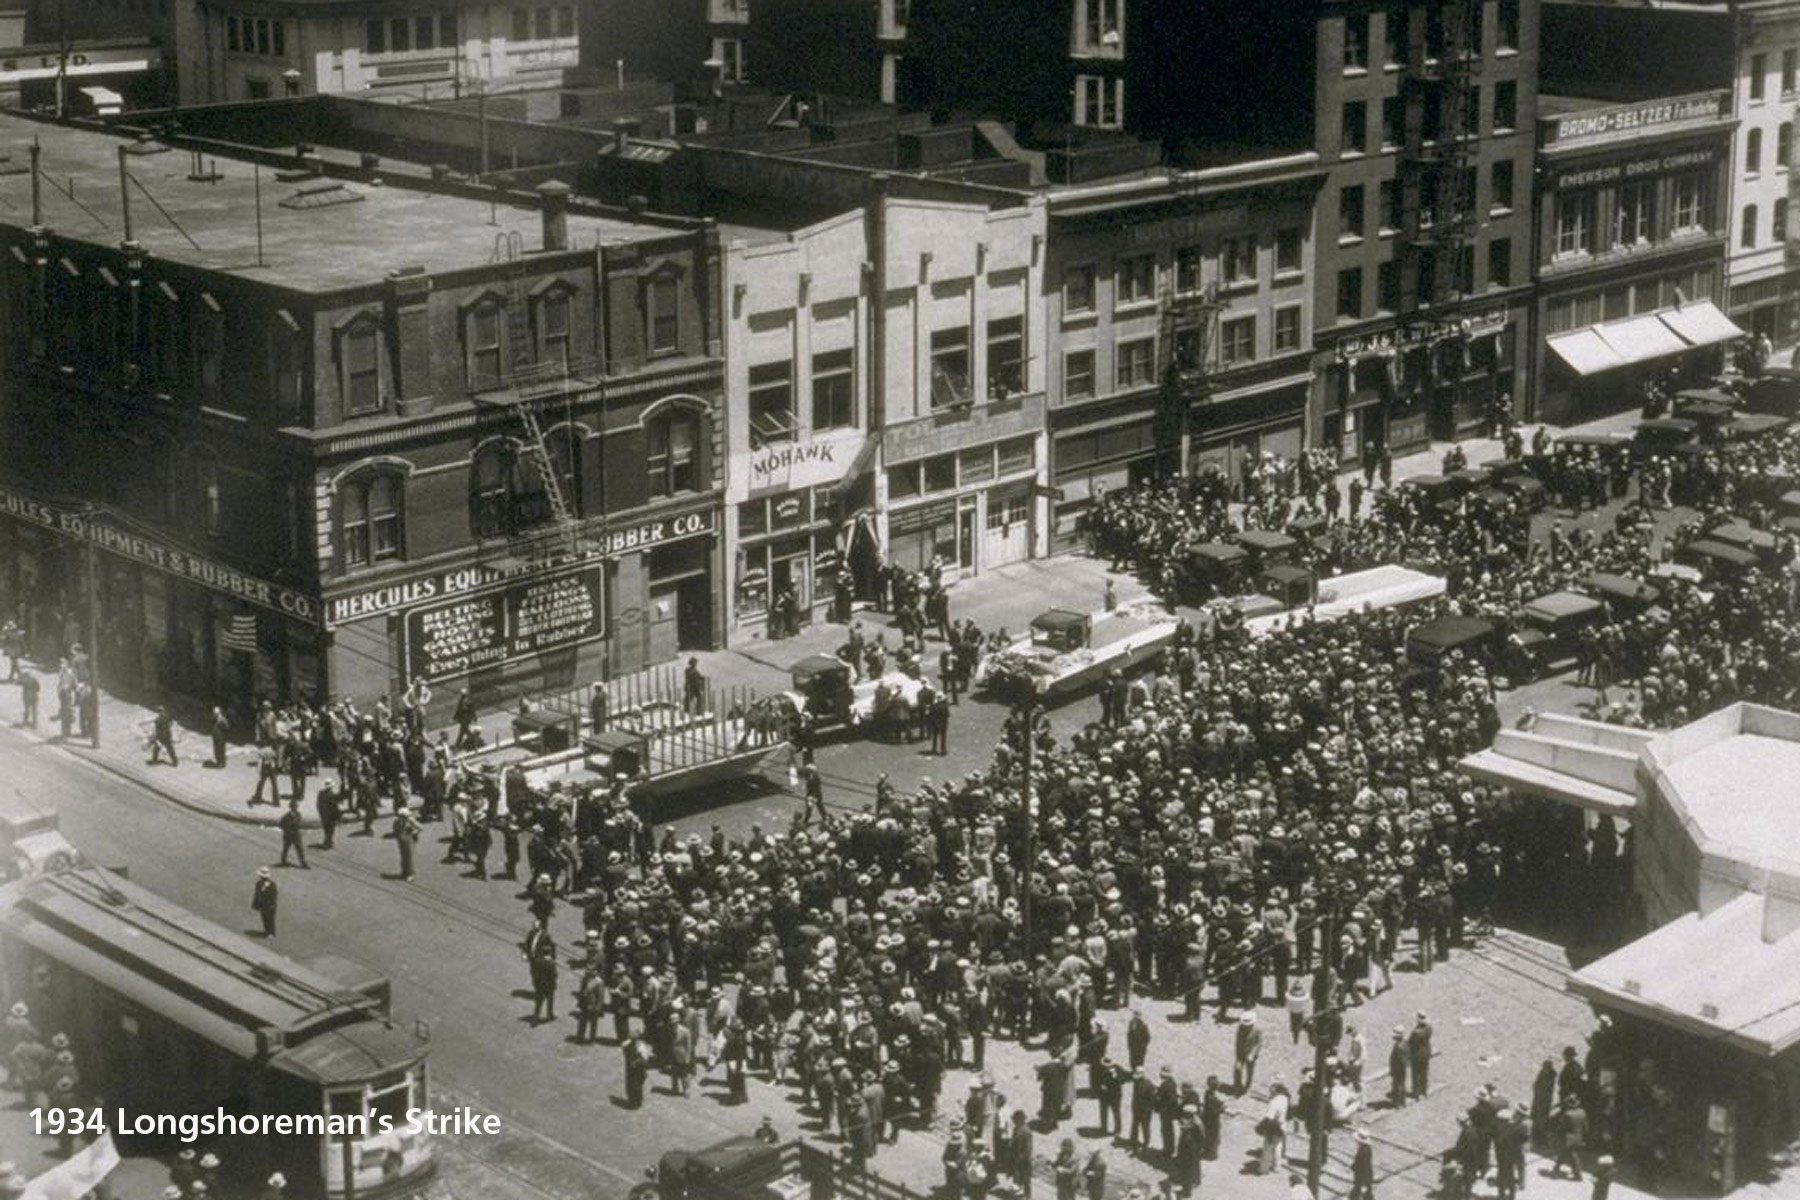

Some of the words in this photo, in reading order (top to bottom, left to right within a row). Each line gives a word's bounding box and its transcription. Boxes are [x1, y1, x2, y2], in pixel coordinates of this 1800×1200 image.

[1559, 105, 1673, 137] BROMO-SELTZER
[1559, 166, 1621, 188] EMERSON
[1626, 159, 1660, 176] DRUG
[1663, 150, 1713, 169] COMPANY
[754, 445, 834, 480] MOHAWK
[334, 577, 437, 620] HERCULES
[673, 513, 706, 535] CO.
[189, 558, 271, 603] RUBBER
[280, 590, 314, 617] CO.
[423, 599, 493, 624] BELTING
[423, 609, 494, 633] PACKING
[423, 627, 496, 651] GASKETS
[433, 620, 481, 641] HOSE
[430, 637, 491, 659] VALVES
